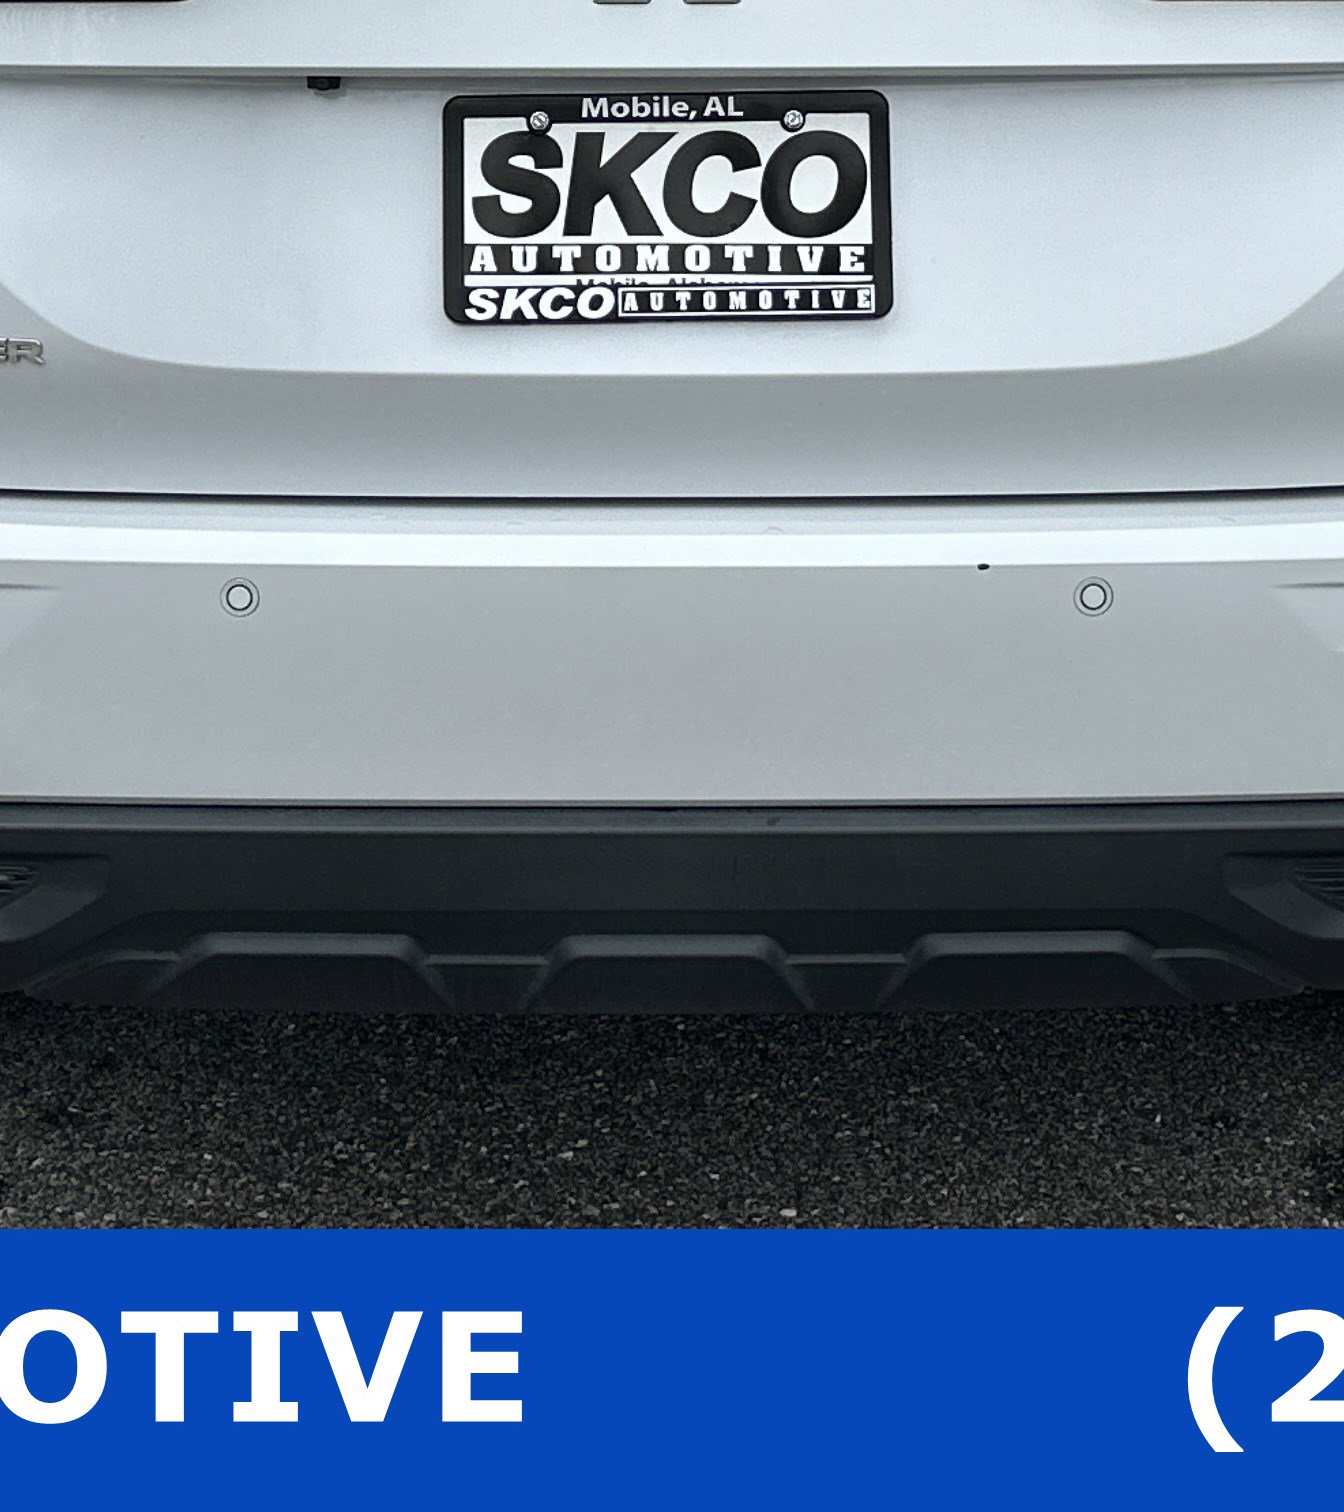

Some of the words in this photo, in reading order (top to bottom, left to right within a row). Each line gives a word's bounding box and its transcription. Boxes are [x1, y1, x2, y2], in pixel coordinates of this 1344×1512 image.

[581, 96, 697, 120] Mobile,
[703, 96, 744, 118] AL
[472, 130, 868, 239] SKCO
[469, 244, 865, 273] AUTOMOTIVE
[464, 287, 616, 321] SKCO
[623, 289, 871, 311] AUTOMOTIVE
